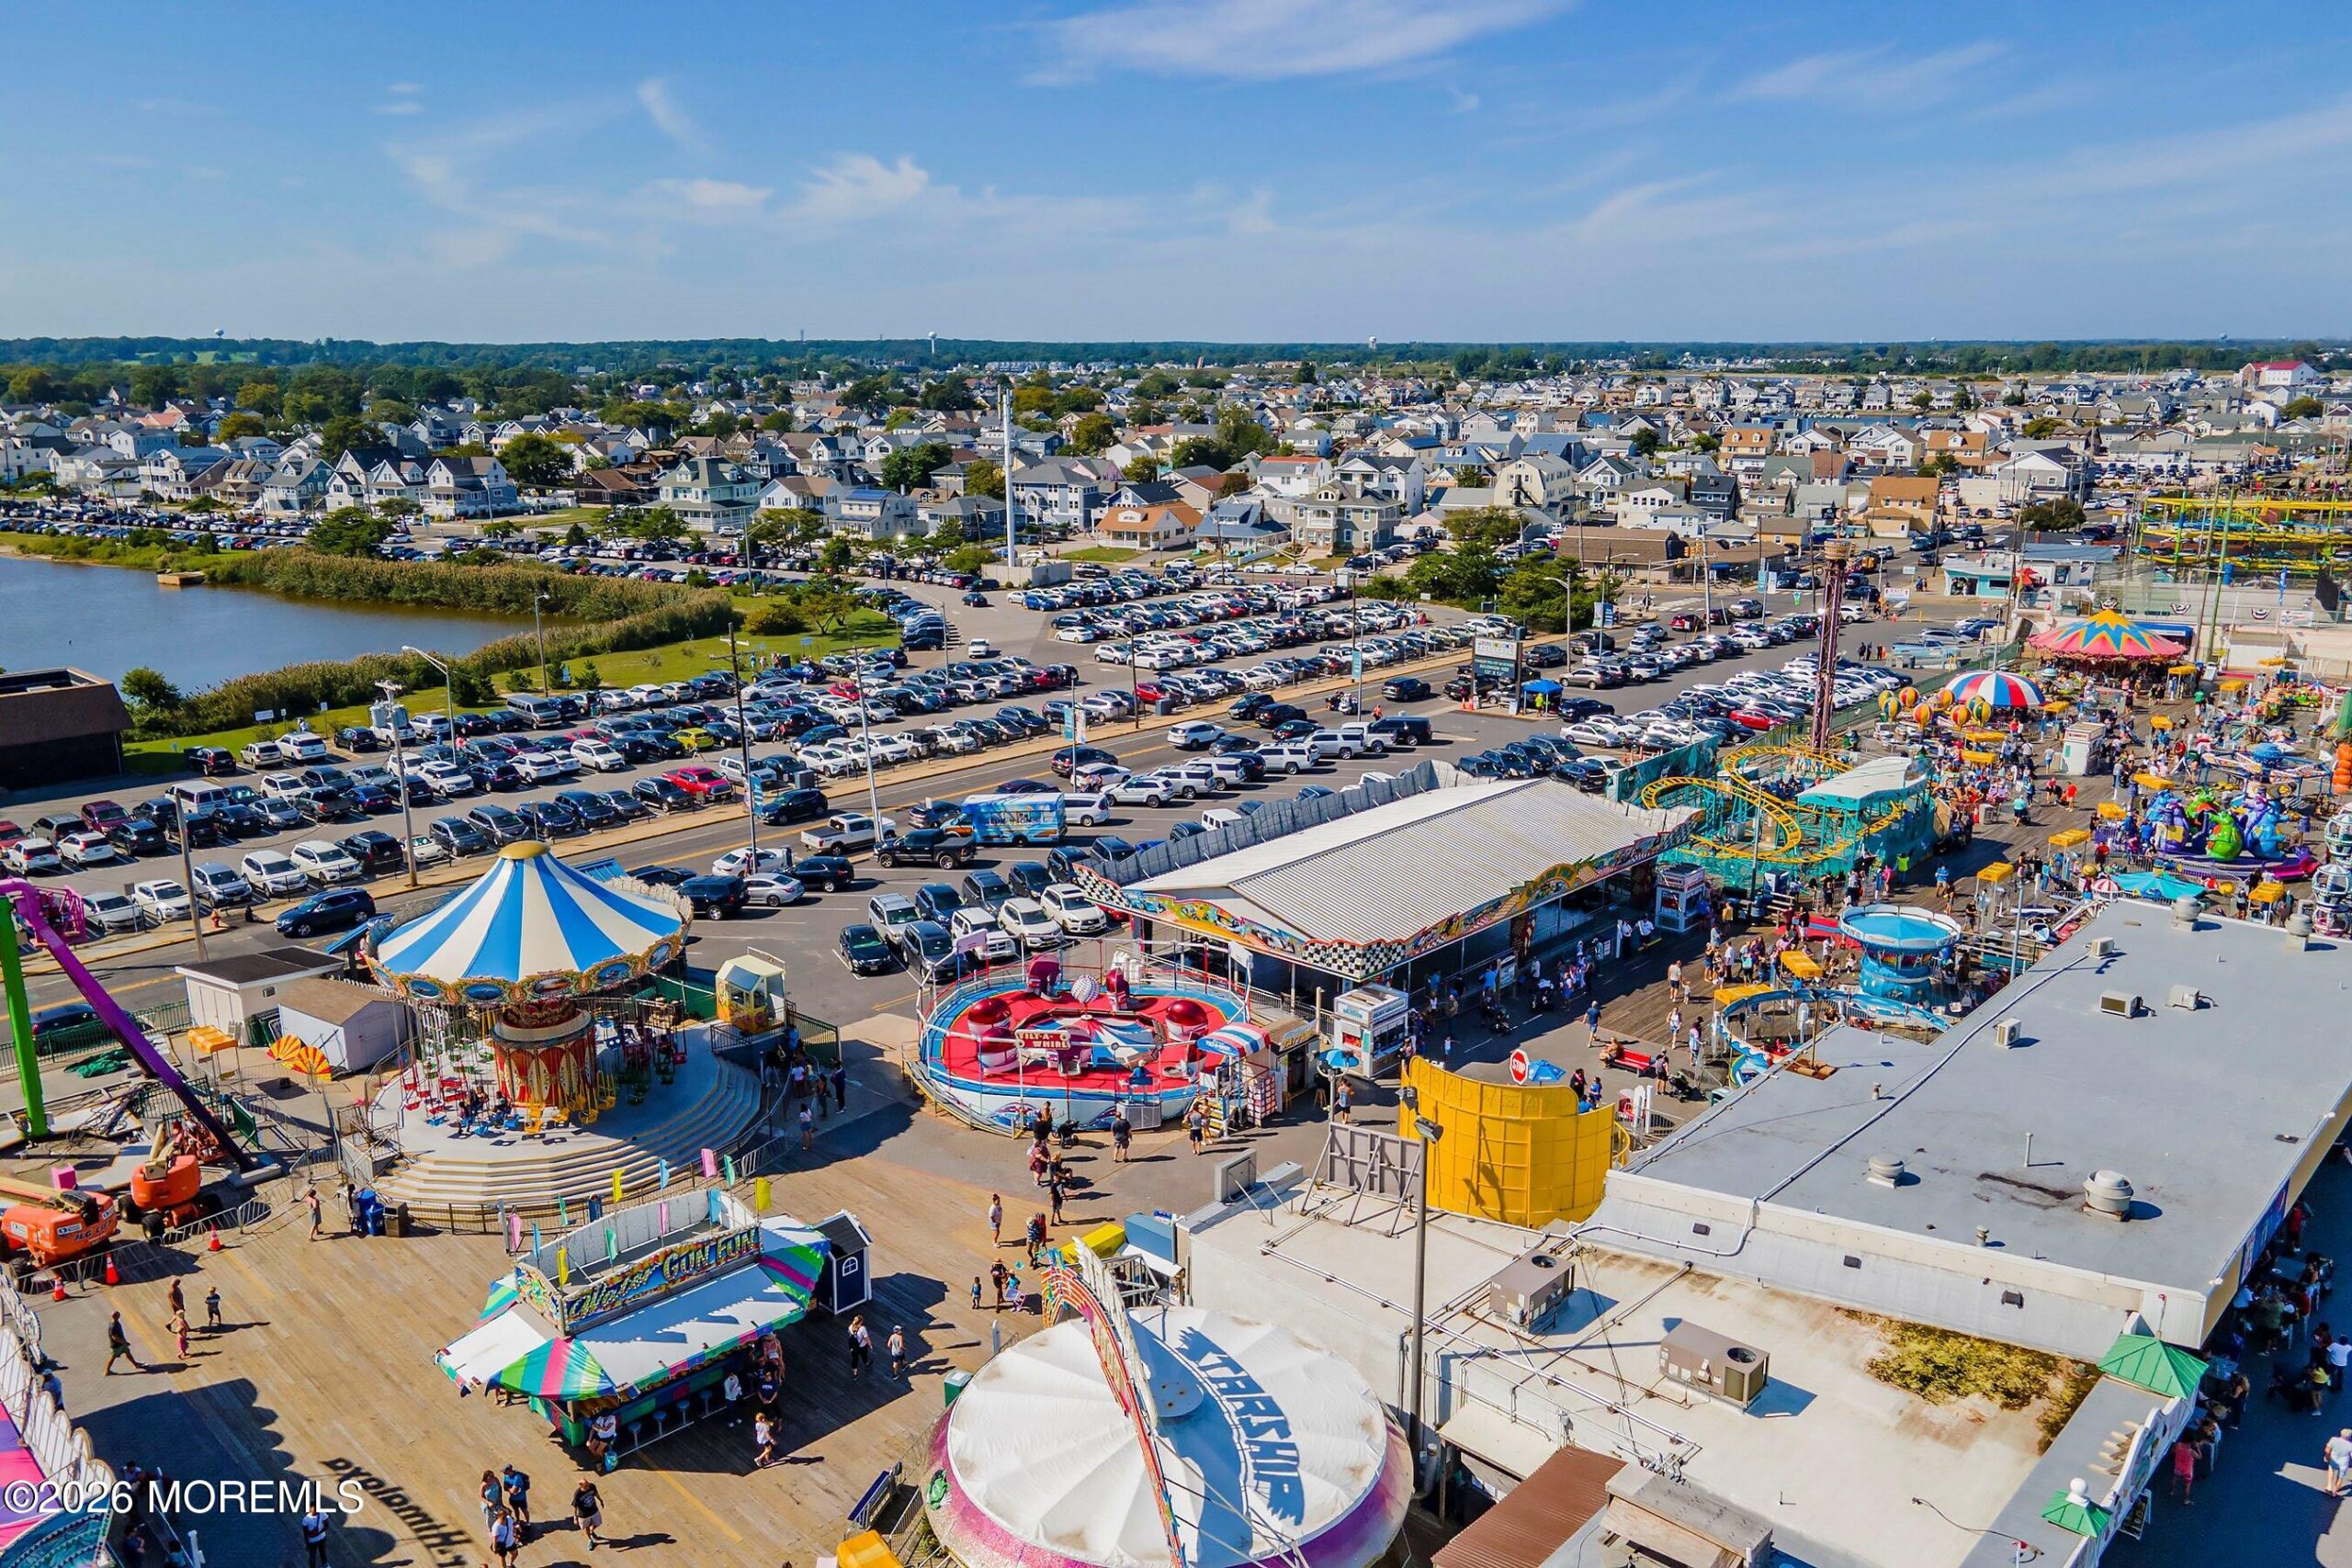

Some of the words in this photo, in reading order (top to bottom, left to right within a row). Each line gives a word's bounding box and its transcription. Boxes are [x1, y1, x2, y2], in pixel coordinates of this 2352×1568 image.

[1033, 1040, 1068, 1048] WHIRL
[1511, 1058, 1526, 1074] STOP
[662, 1243, 711, 1281] GUN
[715, 1227, 758, 1268] FUN
